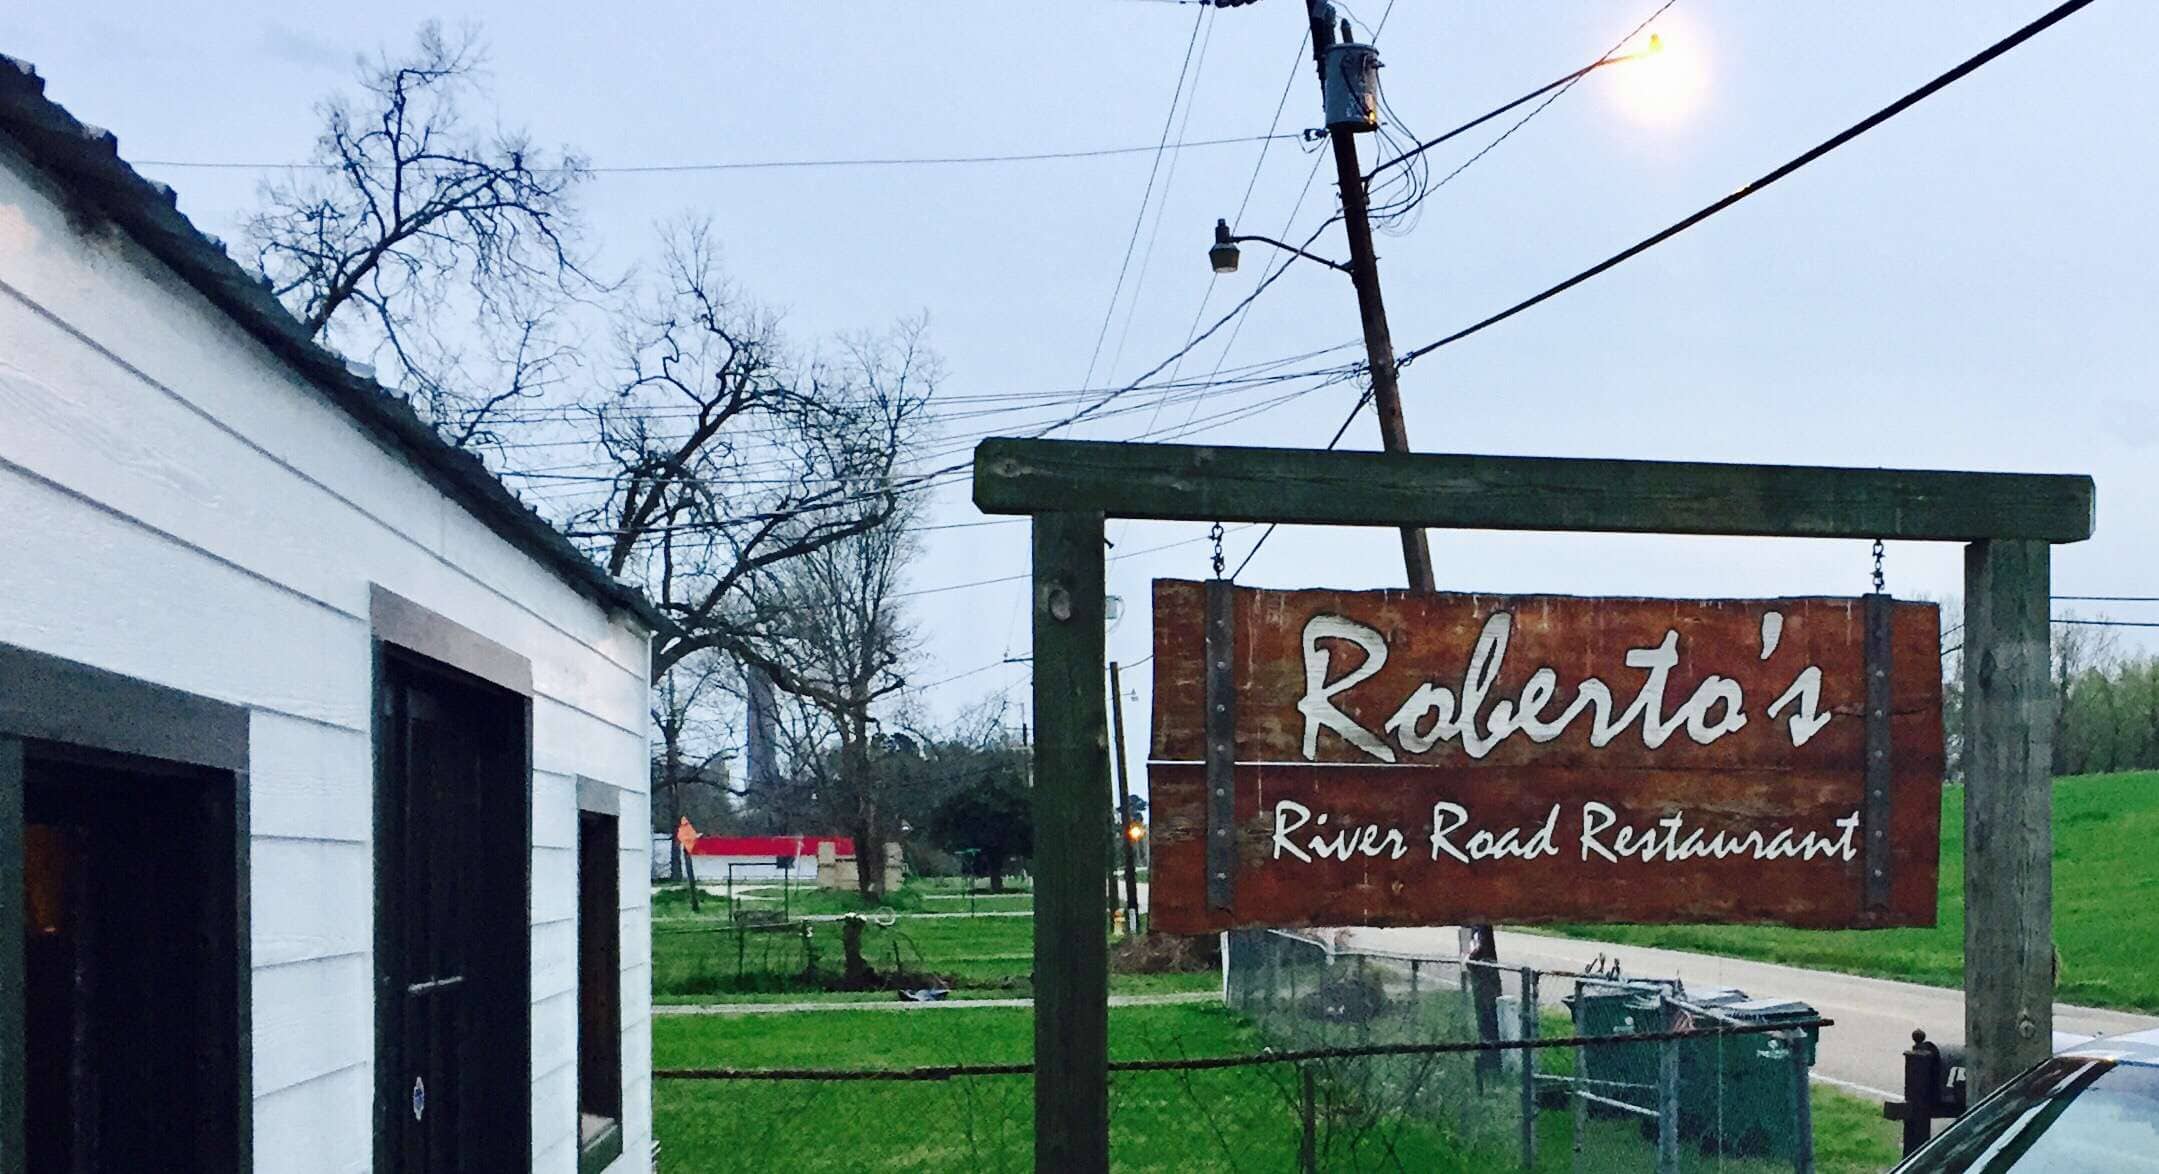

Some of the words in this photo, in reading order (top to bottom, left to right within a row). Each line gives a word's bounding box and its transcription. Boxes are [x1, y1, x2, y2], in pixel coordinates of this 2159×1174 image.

[1298, 611, 1833, 764] Roberto's
[1271, 799, 1408, 864] River
[1430, 801, 1562, 864] Road
[1580, 801, 1861, 864] Restaurant
